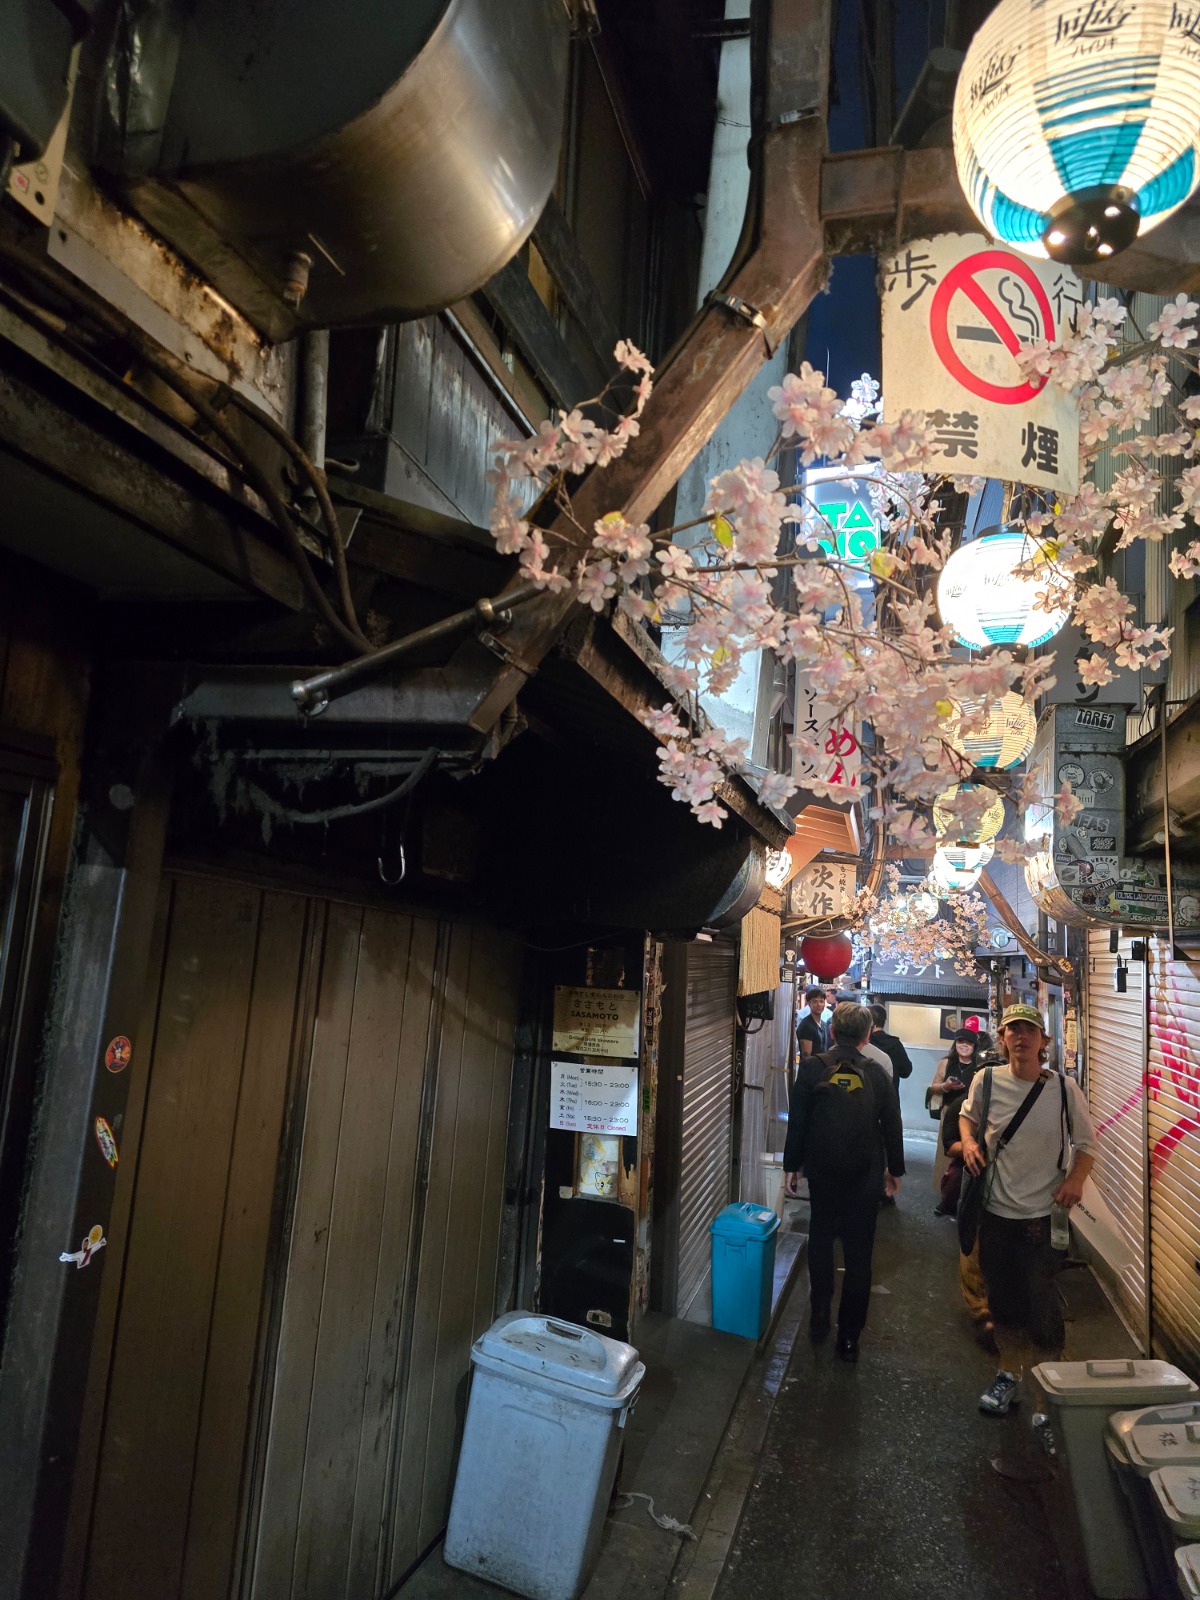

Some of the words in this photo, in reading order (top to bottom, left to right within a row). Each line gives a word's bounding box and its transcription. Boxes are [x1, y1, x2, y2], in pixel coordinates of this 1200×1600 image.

[809, 865, 835, 915] 次作
[573, 1000, 617, 1011] ささもと
[571, 1010, 619, 1021] SASAMOTO
